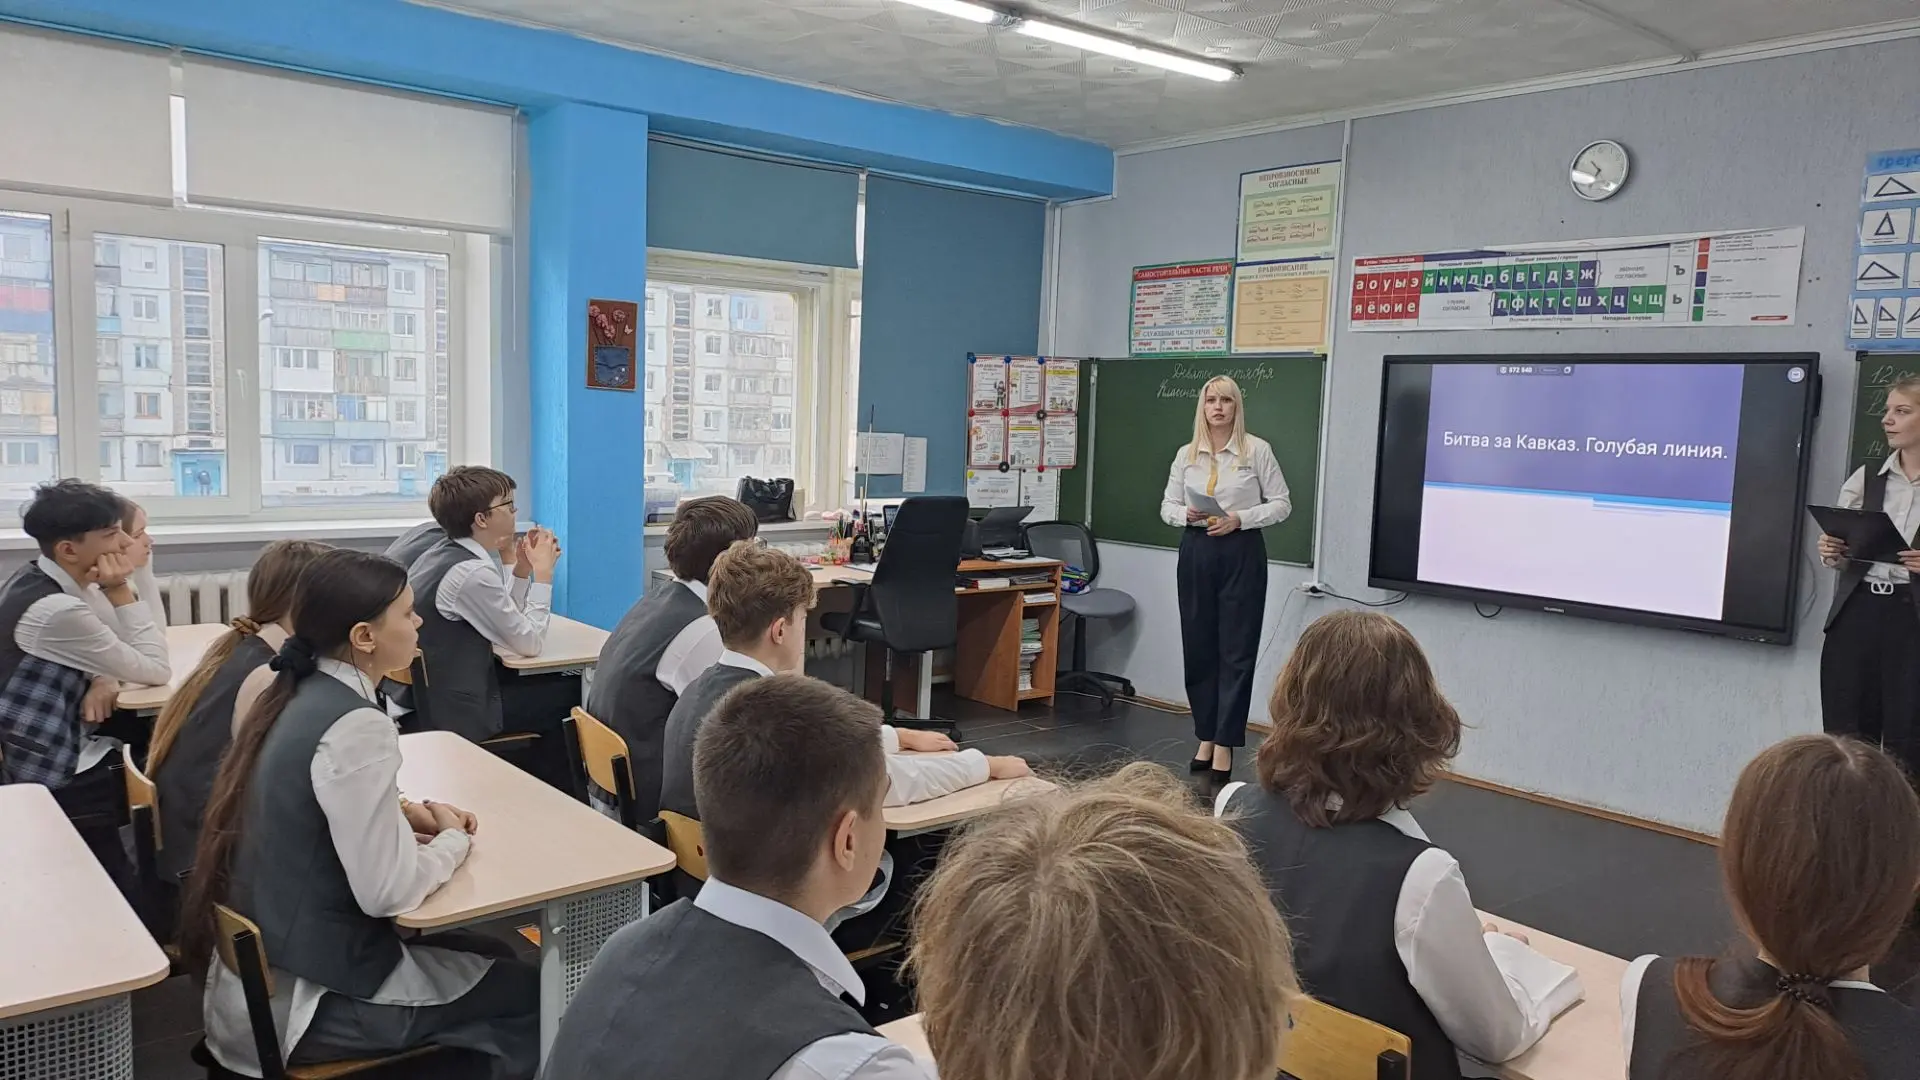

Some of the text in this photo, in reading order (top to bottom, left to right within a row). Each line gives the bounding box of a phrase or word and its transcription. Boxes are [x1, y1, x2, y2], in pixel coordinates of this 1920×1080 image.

[1268, 177, 1308, 188] СОГЛАСНЫЕ
[1356, 281, 1364, 290] а
[1369, 280, 1378, 290] о
[1383, 279, 1391, 292] у
[1394, 278, 1407, 288] ы
[1410, 277, 1419, 288] э
[1439, 276, 1448, 286] н
[1453, 275, 1464, 286] м
[1483, 273, 1494, 287] р
[1500, 269, 1509, 284] б
[1516, 271, 1525, 283] в
[1532, 271, 1541, 283] г
[1547, 270, 1558, 284] д
[1354, 304, 1362, 314] я
[1367, 301, 1376, 314] ё
[1380, 303, 1391, 314] ю
[1394, 302, 1403, 313] и
[1407, 302, 1416, 313] е
[1497, 298, 1507, 309] п
[1511, 294, 1525, 312] ф
[1546, 297, 1556, 308] т
[1614, 295, 1625, 308] ц
[1633, 294, 1642, 305] ч
[1648, 293, 1663, 308] щ
[1157, 379, 1201, 398] Классна
[1444, 431, 1728, 459] Битва за Кавказ. Голубая линия.
